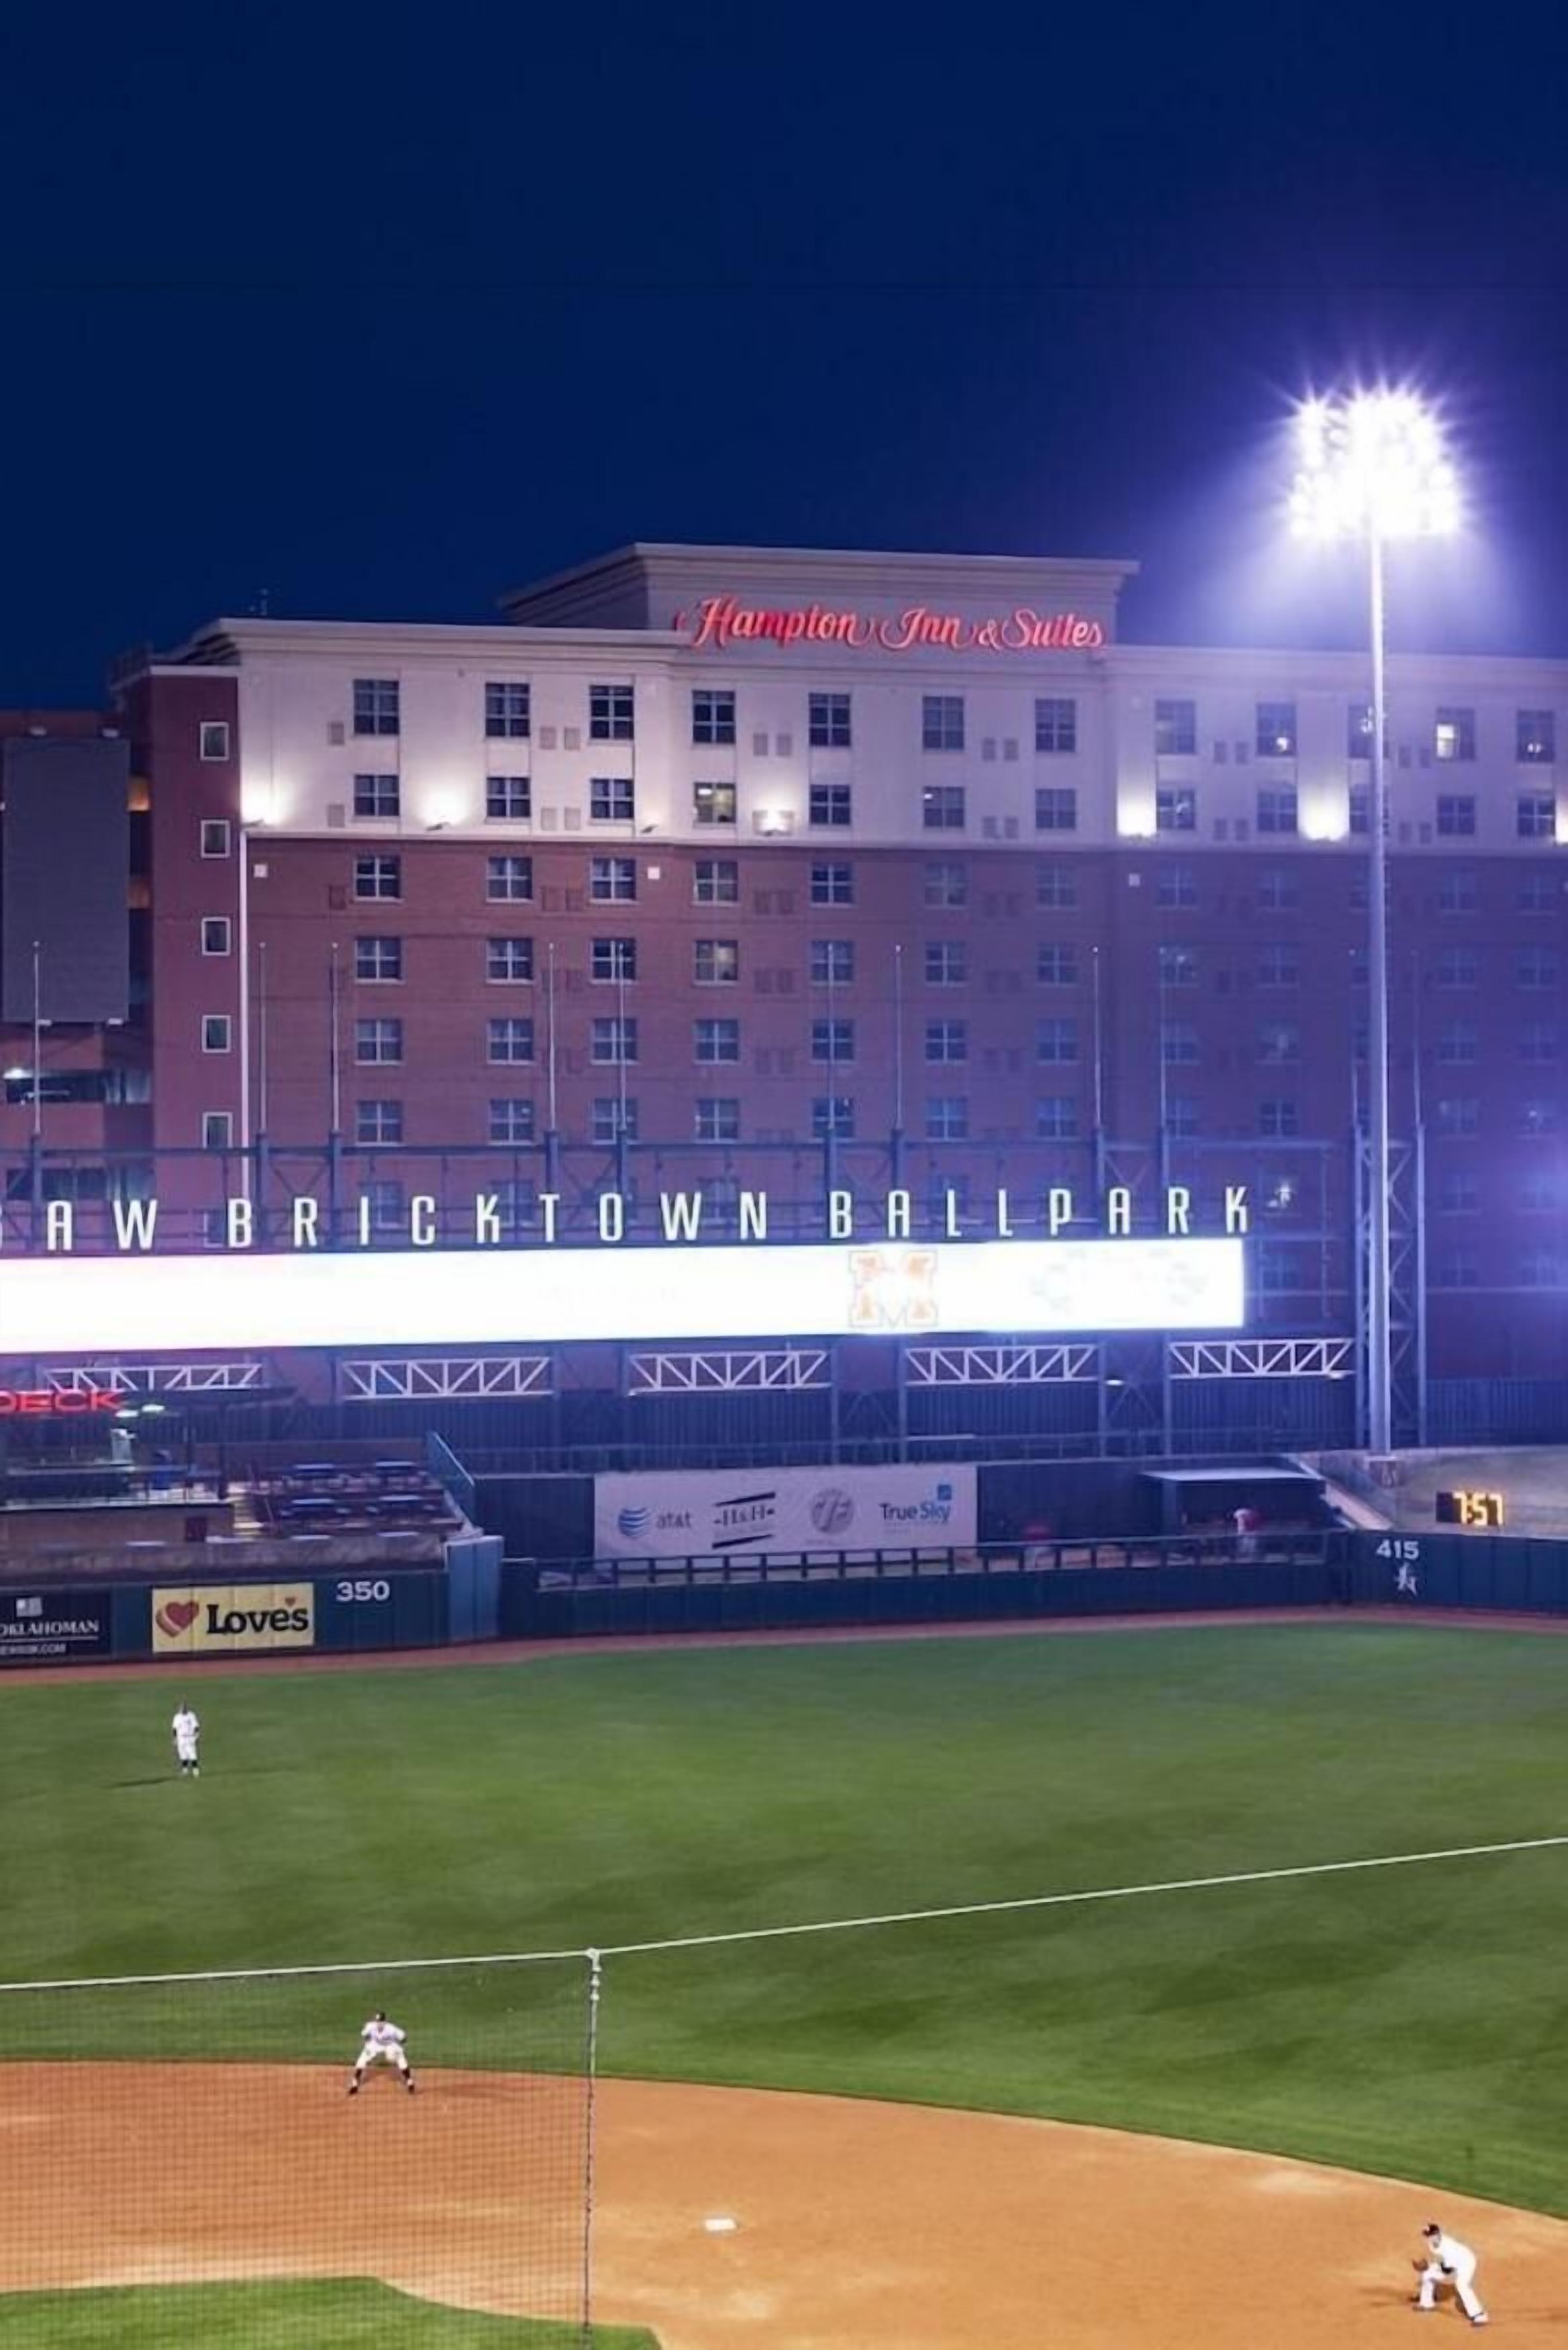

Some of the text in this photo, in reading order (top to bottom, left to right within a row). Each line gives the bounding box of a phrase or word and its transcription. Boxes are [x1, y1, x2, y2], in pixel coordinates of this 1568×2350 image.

[675, 595, 1102, 650] Hampton Inn & Suites
[0, 1186, 1248, 1250] AW BRICKTOWN BALLPARK
[879, 1502, 917, 1521] True
[920, 1500, 951, 1525] Sky
[1376, 1540, 1419, 1560] 415
[336, 1580, 390, 1602] 350
